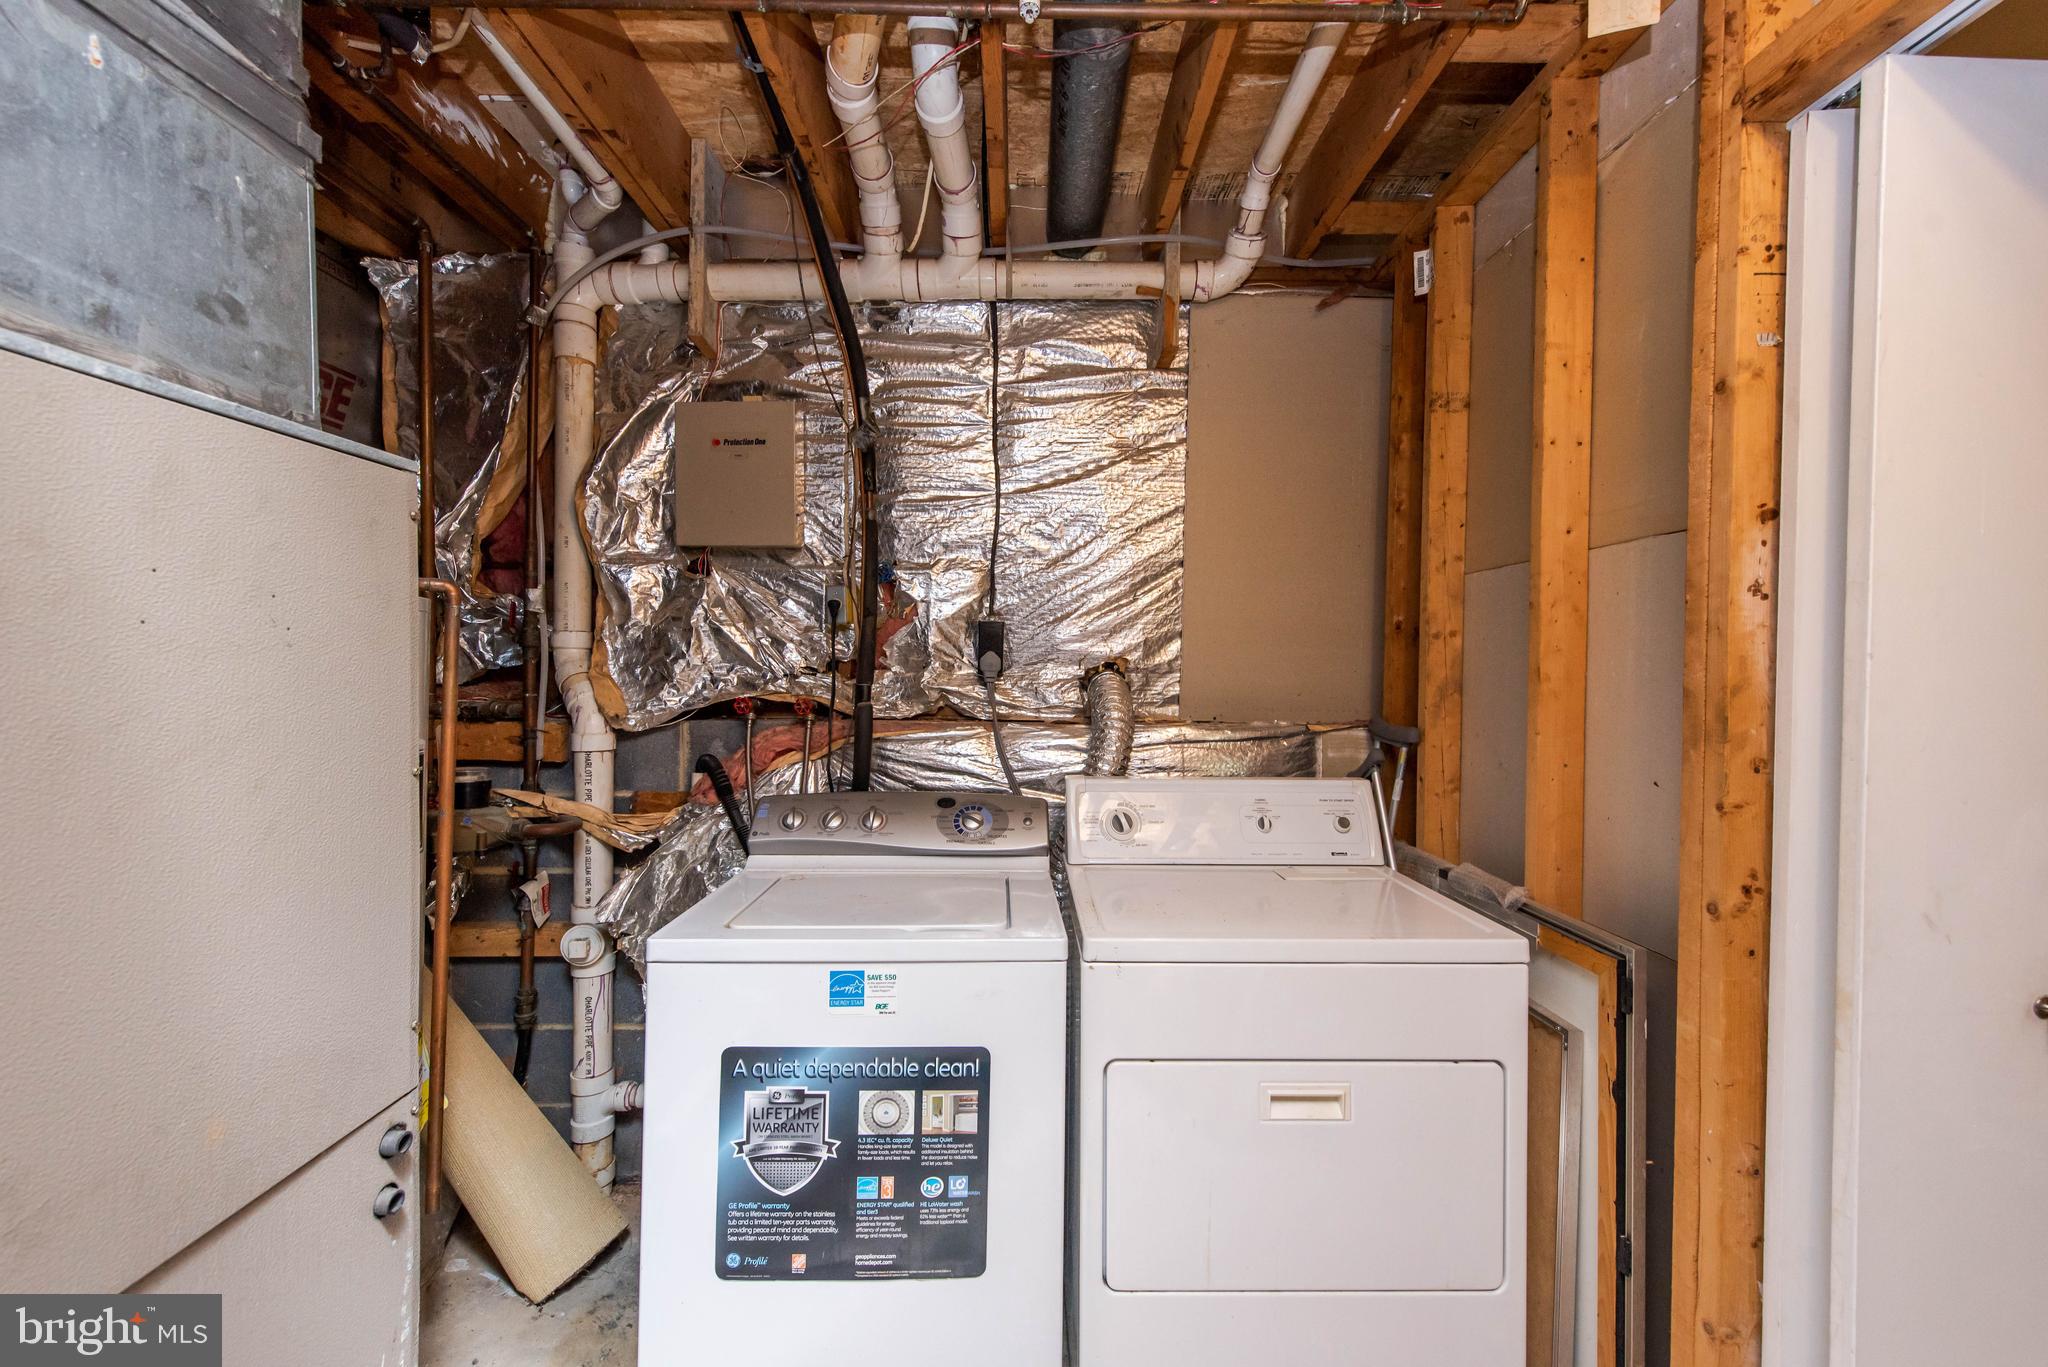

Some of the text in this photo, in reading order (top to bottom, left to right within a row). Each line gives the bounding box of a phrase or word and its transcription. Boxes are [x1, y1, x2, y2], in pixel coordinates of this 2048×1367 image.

[732, 1057, 980, 1083] A quiet dependable clean!
[753, 1107, 819, 1119] LIFETIME
[753, 1122, 819, 1133] WARRANTY
[924, 1181, 940, 1193] he
[744, 1256, 768, 1268] Profile
